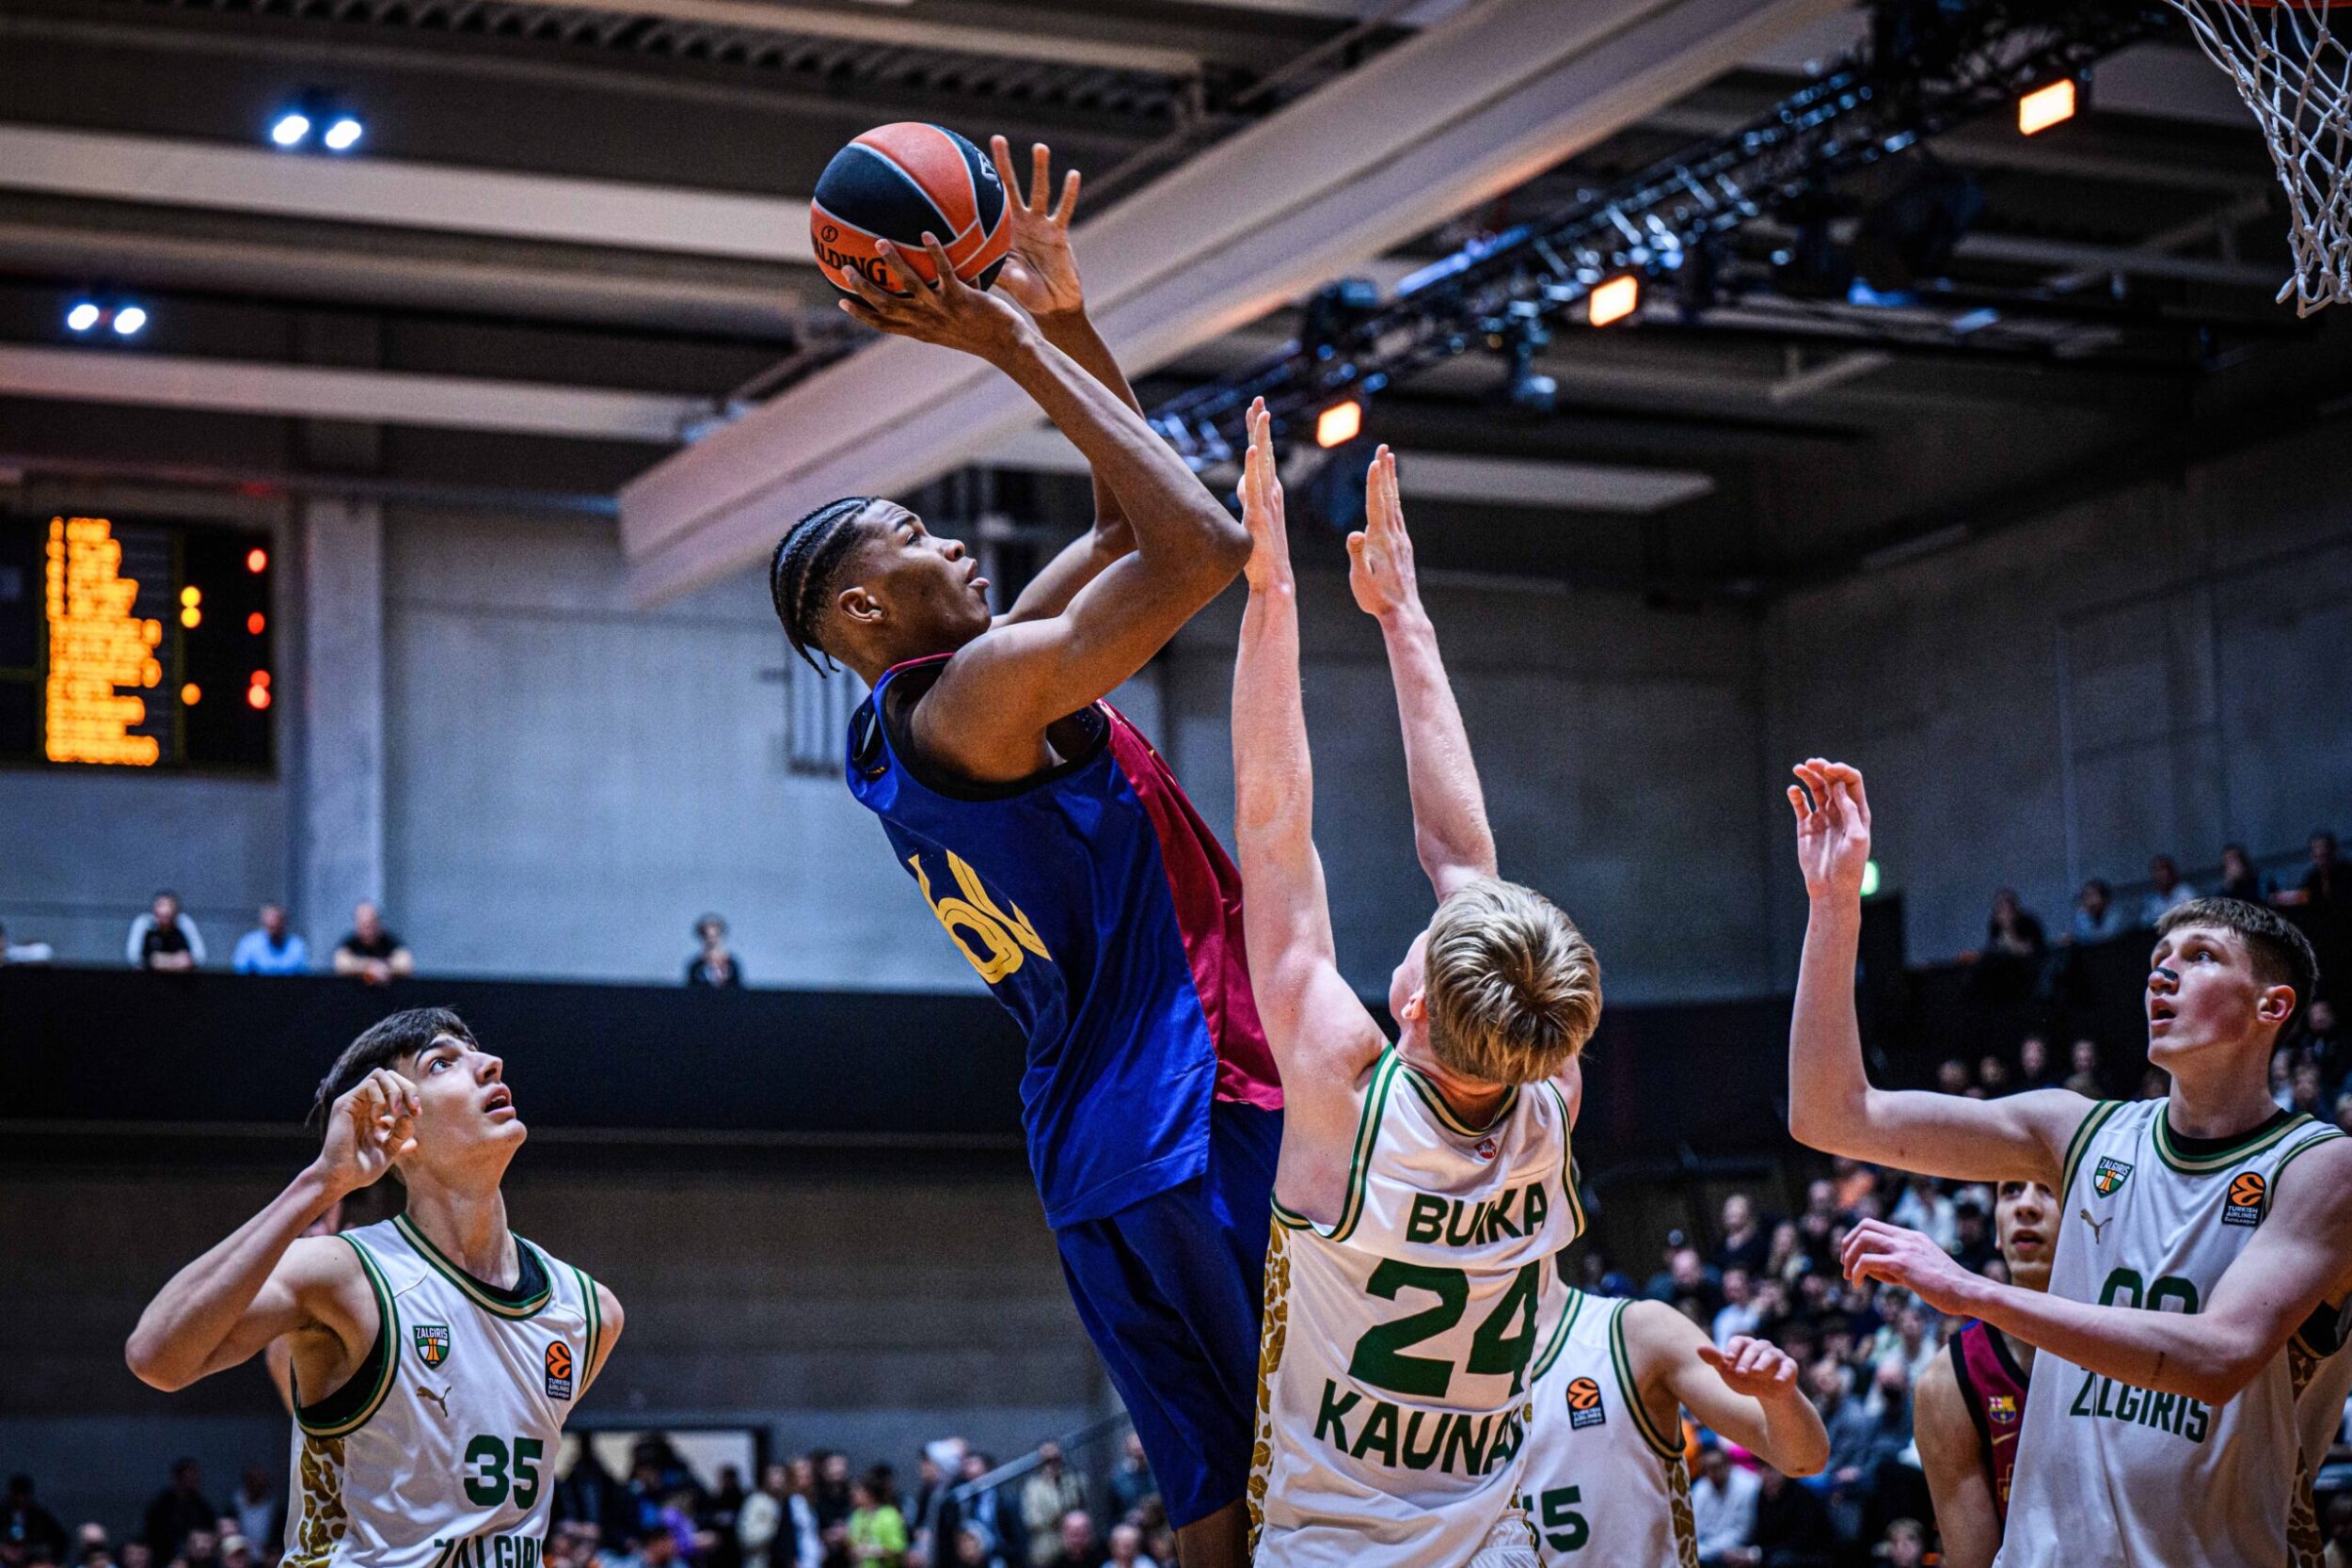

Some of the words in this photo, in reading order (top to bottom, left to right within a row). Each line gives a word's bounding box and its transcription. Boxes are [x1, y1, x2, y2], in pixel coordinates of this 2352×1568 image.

[2226, 1211, 2257, 1219] AIRLINES
[2228, 1205, 2258, 1213] TURKISH
[416, 1327, 448, 1339] ZALGIRIS
[1347, 1258, 1540, 1398] 24
[2070, 1367, 2212, 1443] ZLGIRIS
[464, 1434, 544, 1510] 35
